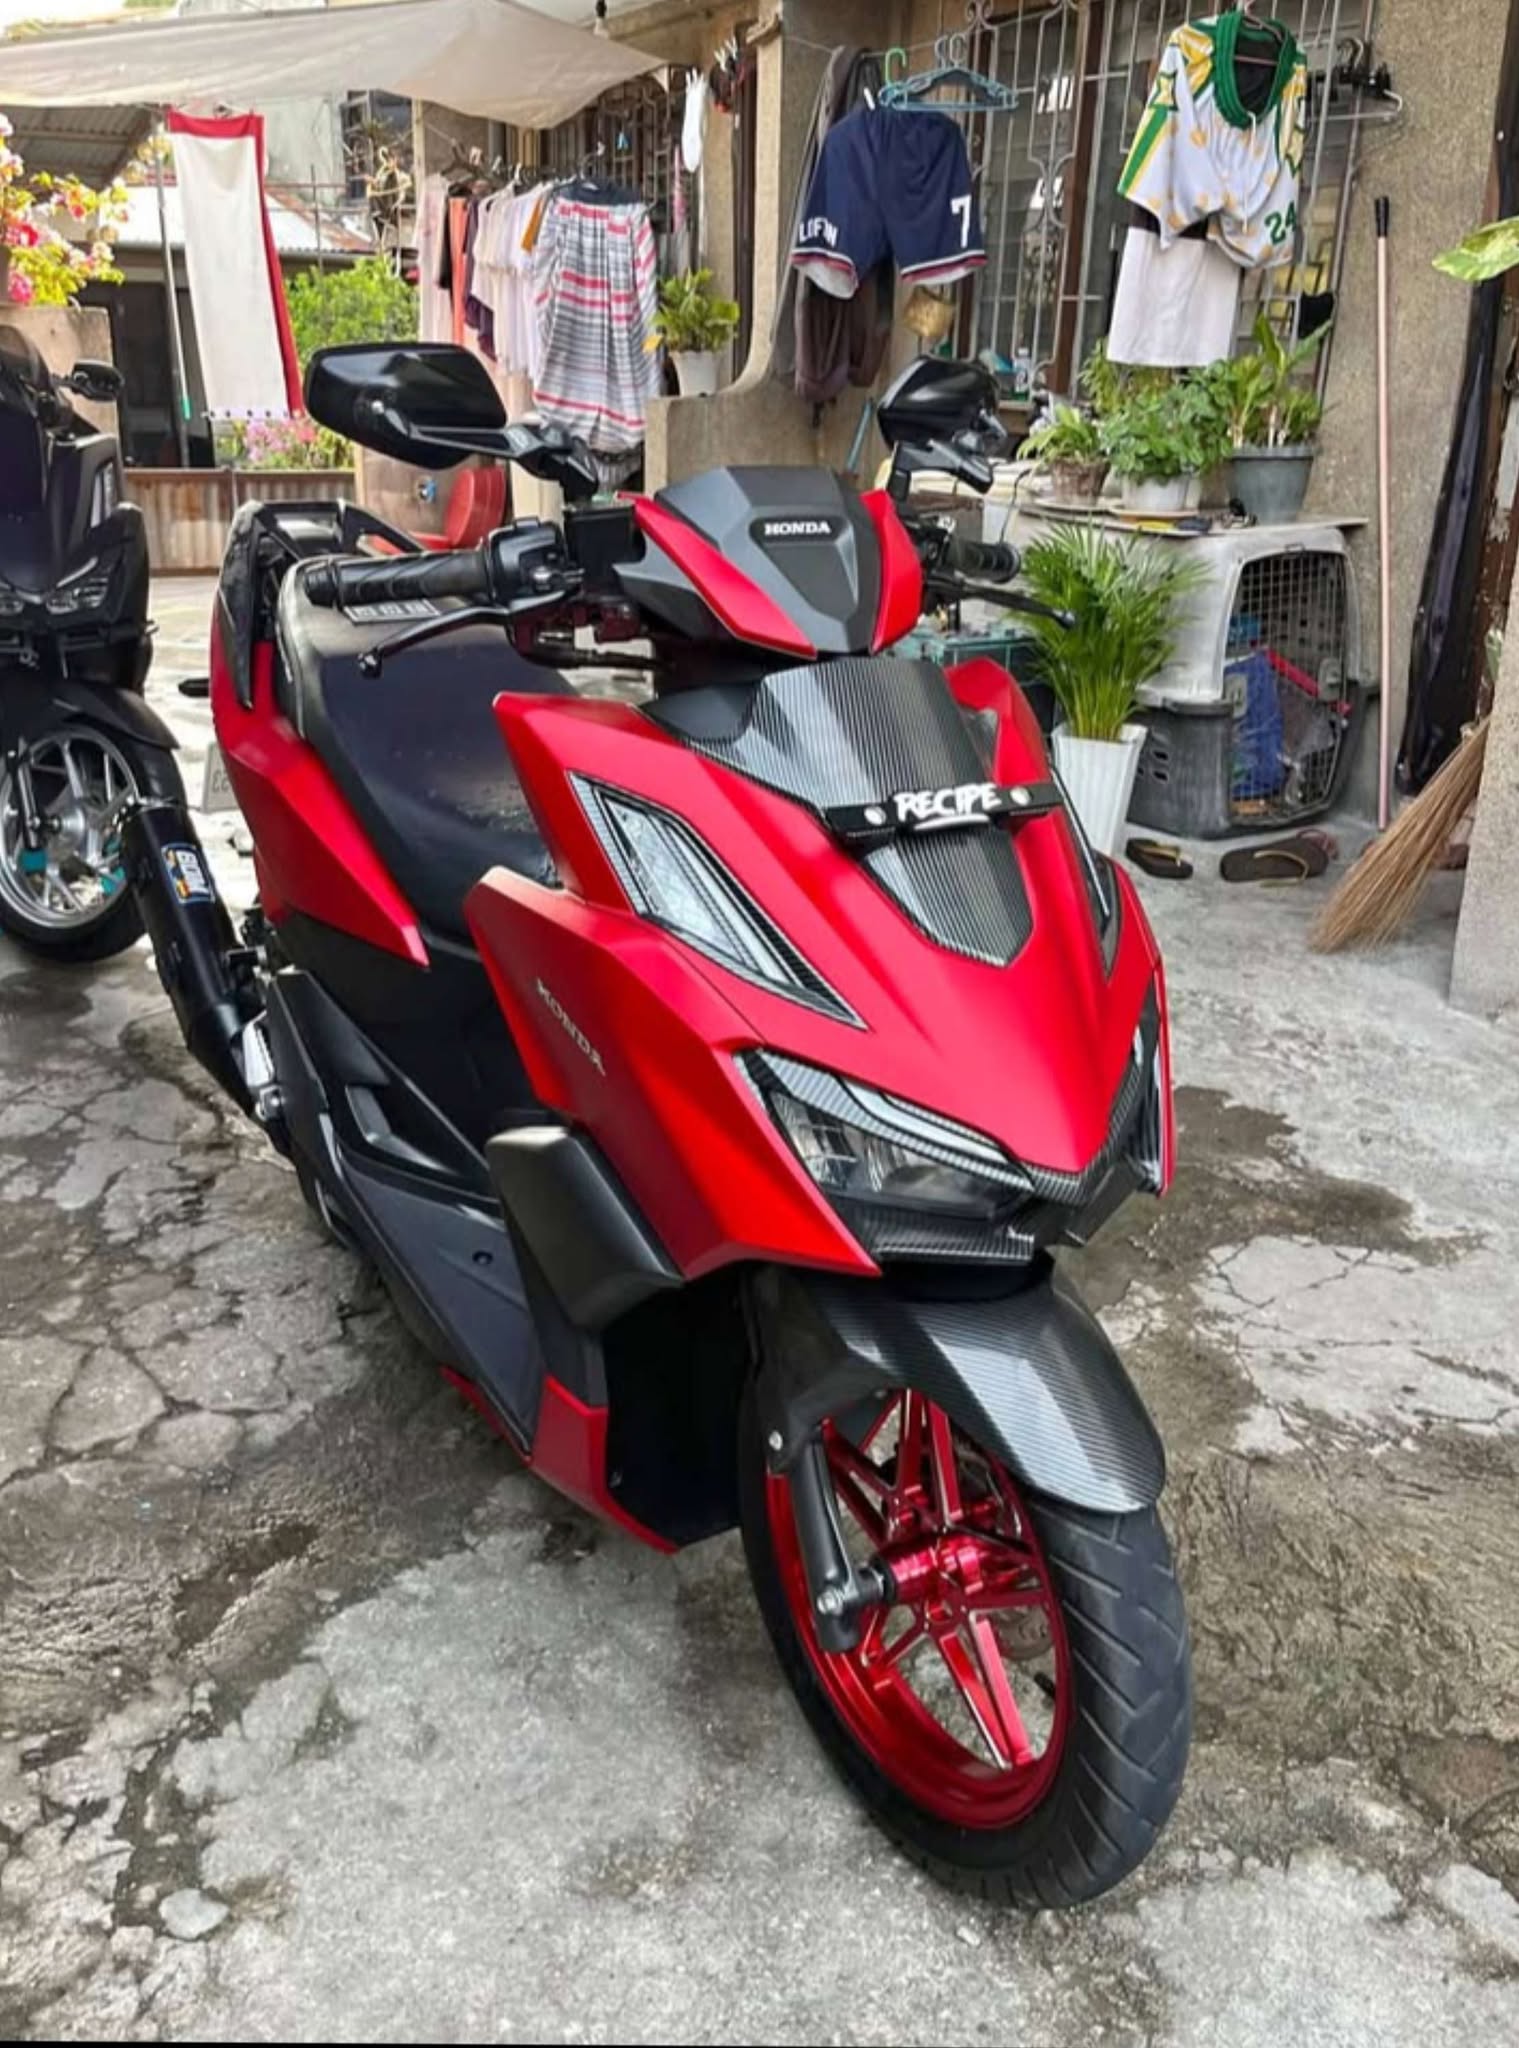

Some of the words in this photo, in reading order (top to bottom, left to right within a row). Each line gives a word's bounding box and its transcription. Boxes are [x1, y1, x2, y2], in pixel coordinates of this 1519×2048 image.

[951, 195, 972, 249] 7
[1264, 201, 1297, 245] 24
[763, 520, 832, 536] HONDA
[893, 782, 1003, 822] RECIPE
[536, 977, 607, 1077] HONDA
